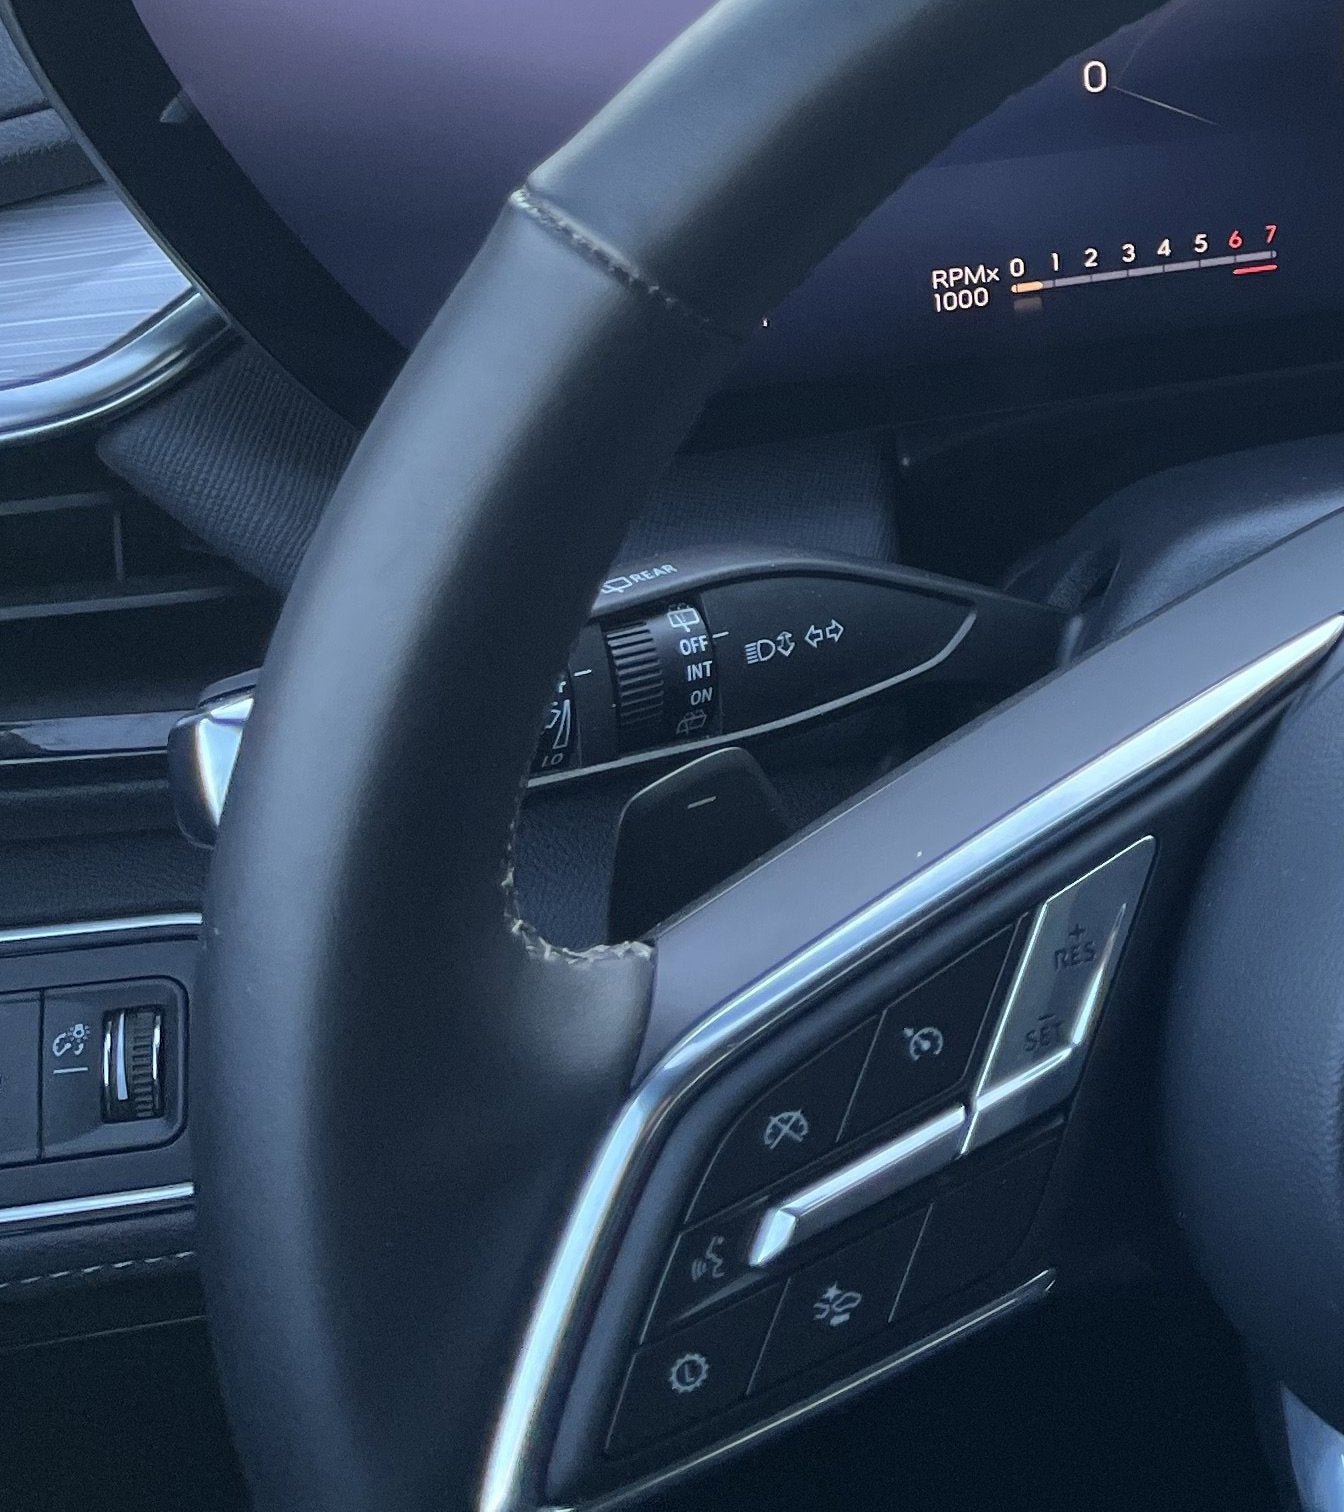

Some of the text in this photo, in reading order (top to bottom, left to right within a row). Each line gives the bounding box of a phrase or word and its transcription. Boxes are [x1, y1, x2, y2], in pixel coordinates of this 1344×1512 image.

[1082, 60, 1107, 93] 0
[1010, 224, 1278, 279] 0 1 2 3 4 5 6 7
[932, 264, 1000, 290] RPMx
[933, 288, 989, 313] 1000
[630, 564, 678, 584] REAR
[679, 635, 709, 656] OFF
[687, 660, 713, 682] INT
[690, 686, 714, 706] ON
[1054, 940, 1097, 972] RES
